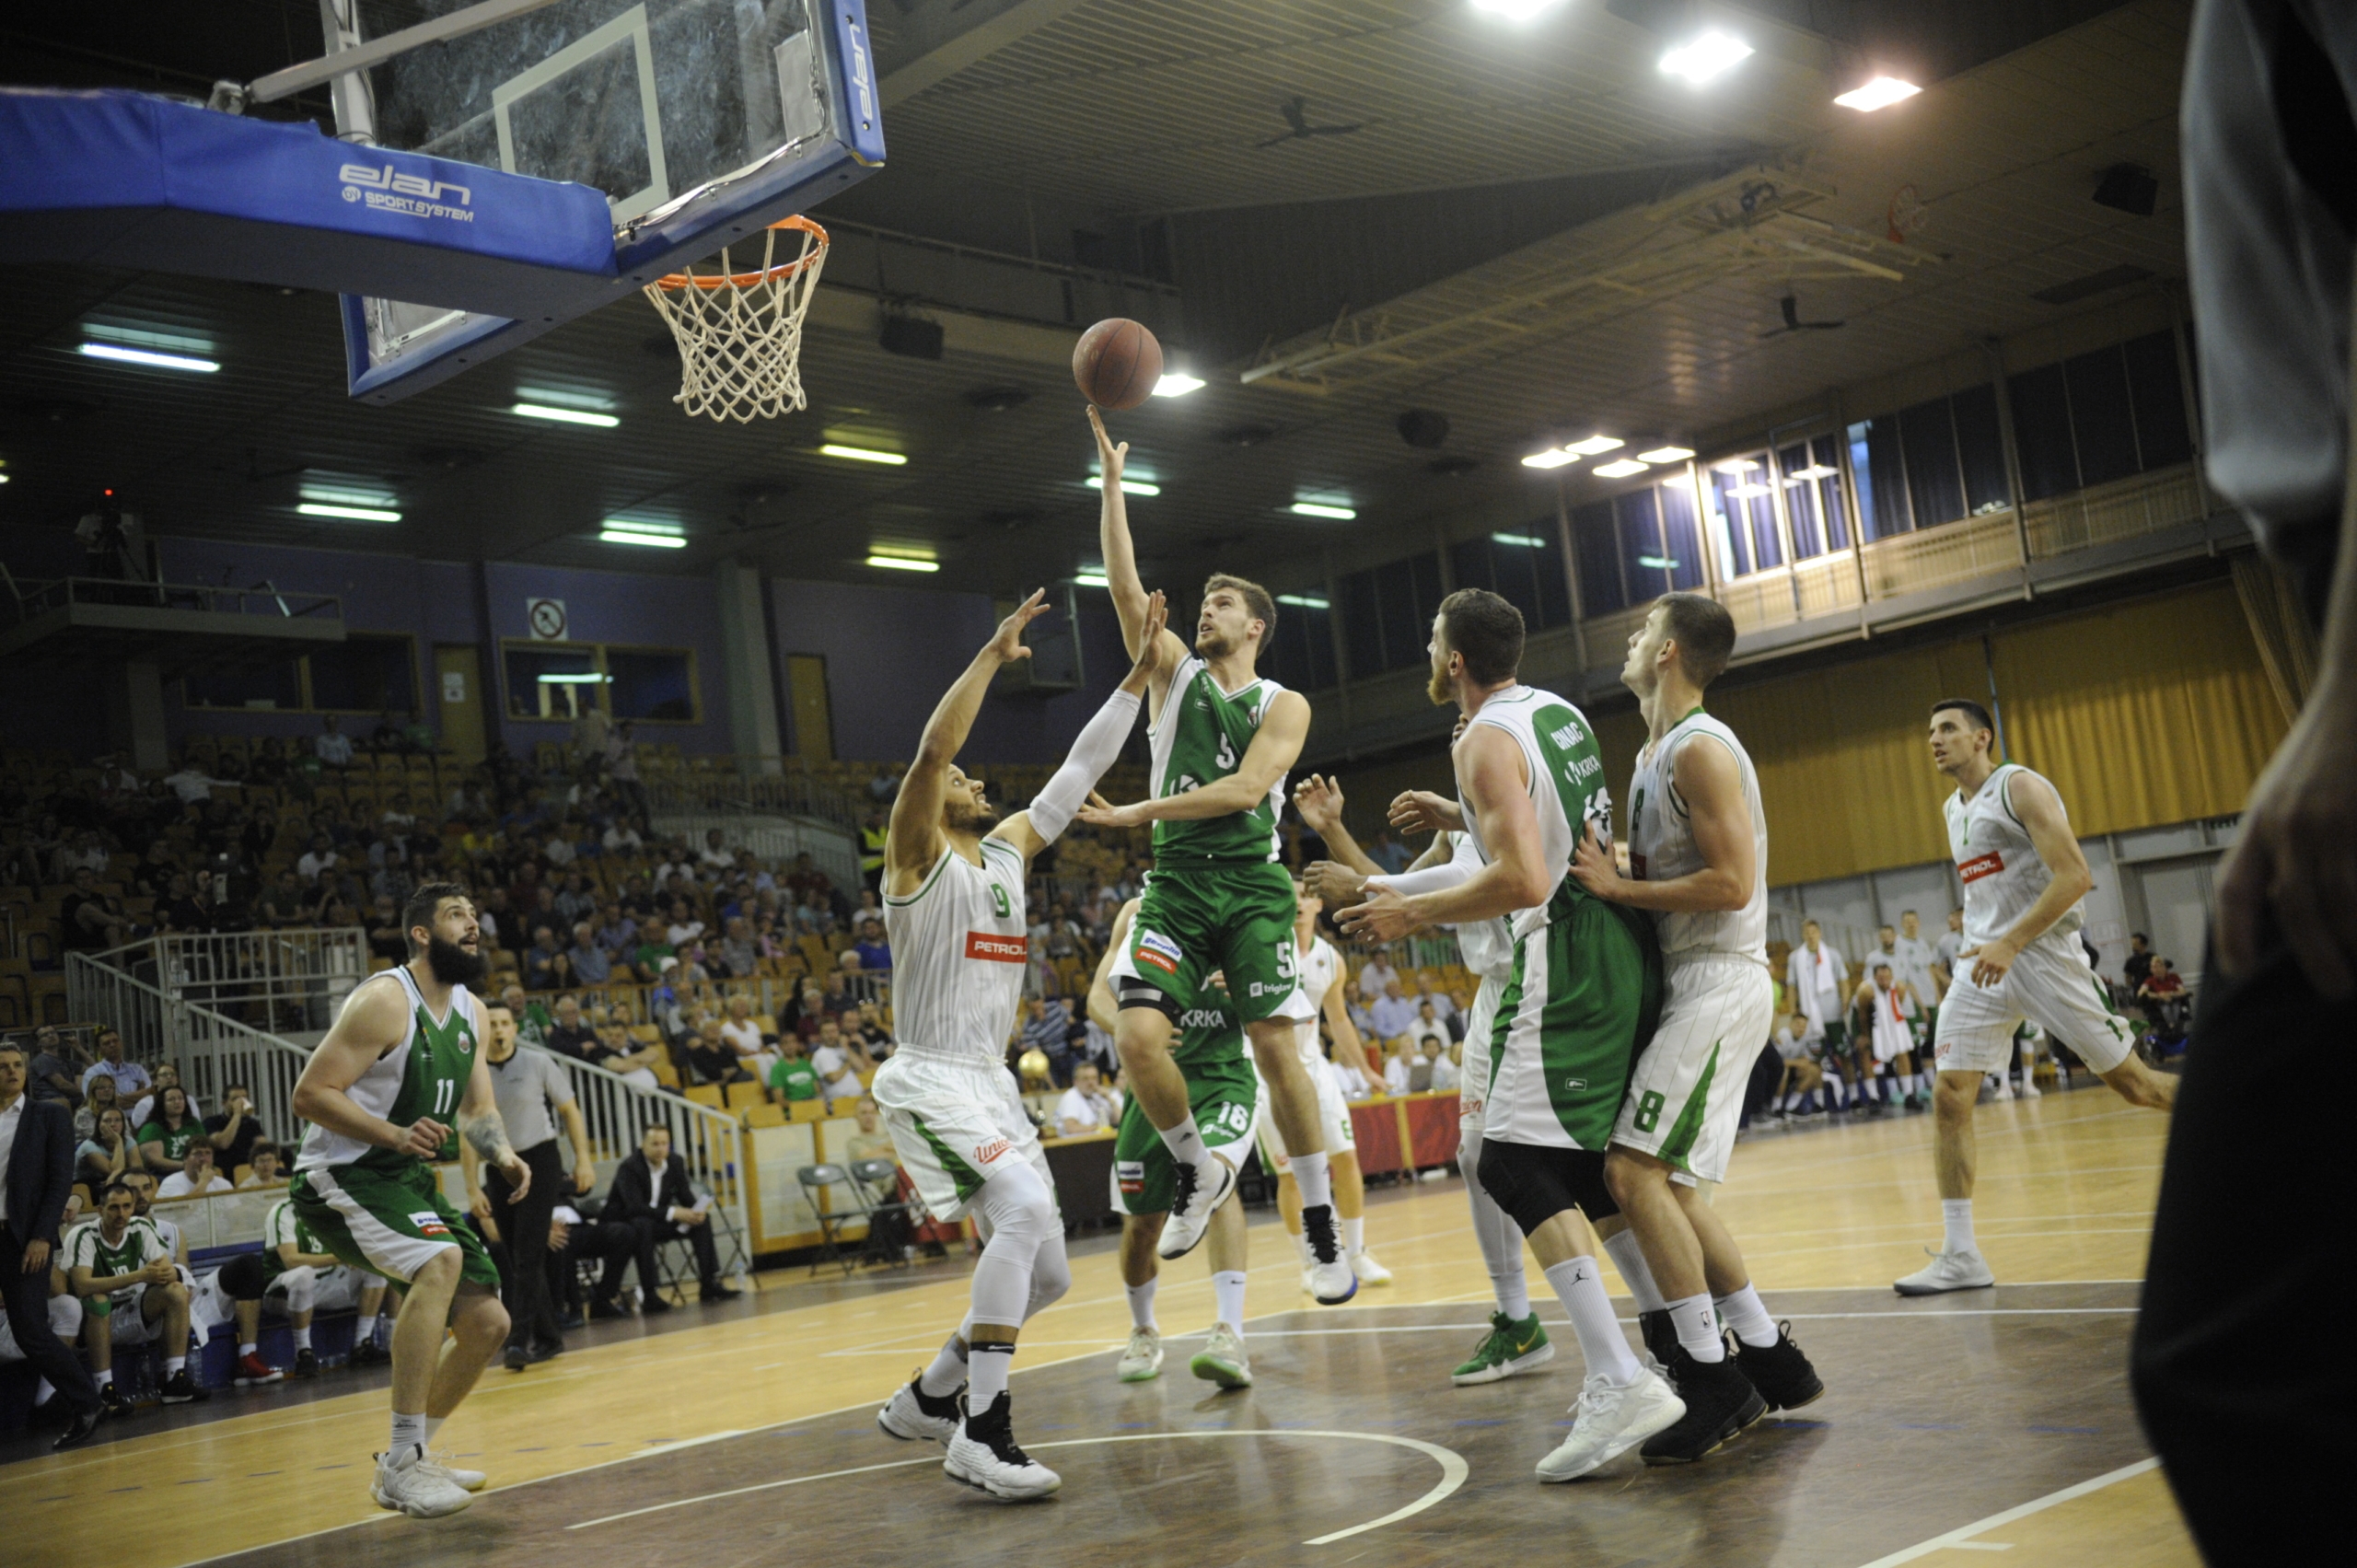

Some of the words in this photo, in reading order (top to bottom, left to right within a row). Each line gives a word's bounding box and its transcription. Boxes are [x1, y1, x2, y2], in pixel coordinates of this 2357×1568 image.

[850, 23, 873, 121] elan
[339, 164, 470, 205] elan
[1959, 859, 1997, 879] ETROL
[990, 883, 1011, 918] 9
[974, 940, 1028, 956] PETROL
[1276, 941, 1295, 979] 5
[1263, 982, 1293, 995] triglav
[1180, 1009, 1228, 1028] KRKA
[434, 1079, 455, 1114] 11
[1632, 1089, 1666, 1133] 8
[1217, 1101, 1249, 1132] 16
